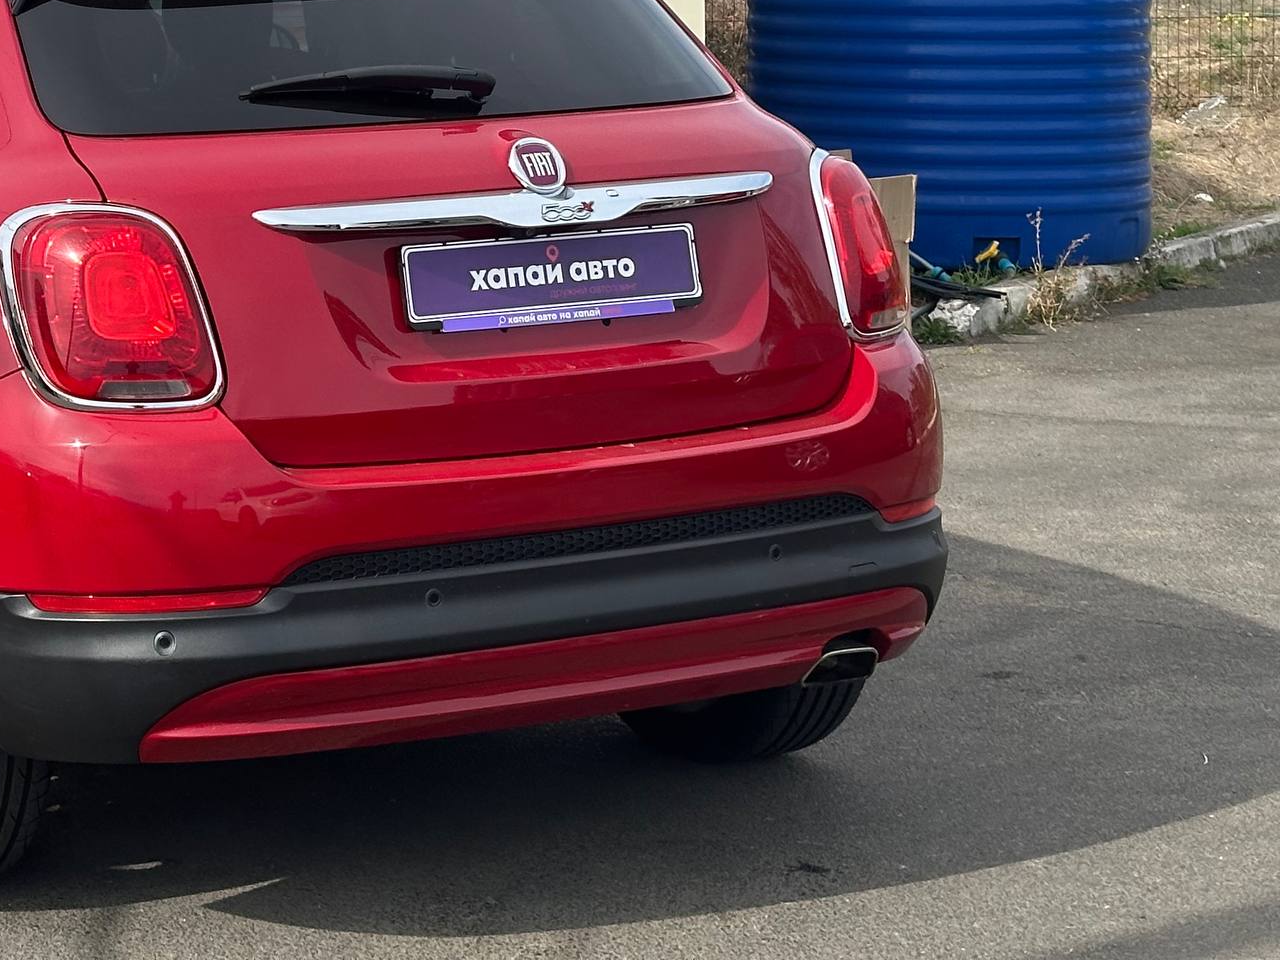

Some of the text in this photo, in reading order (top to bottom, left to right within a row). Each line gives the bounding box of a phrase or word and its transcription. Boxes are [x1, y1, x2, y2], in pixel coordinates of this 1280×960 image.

[521, 151, 556, 178] FIAT
[569, 257, 635, 281] авто
[508, 313, 536, 324] хапай
[537, 313, 558, 321] авто
[559, 311, 571, 320] на
[573, 307, 601, 318] хапай
